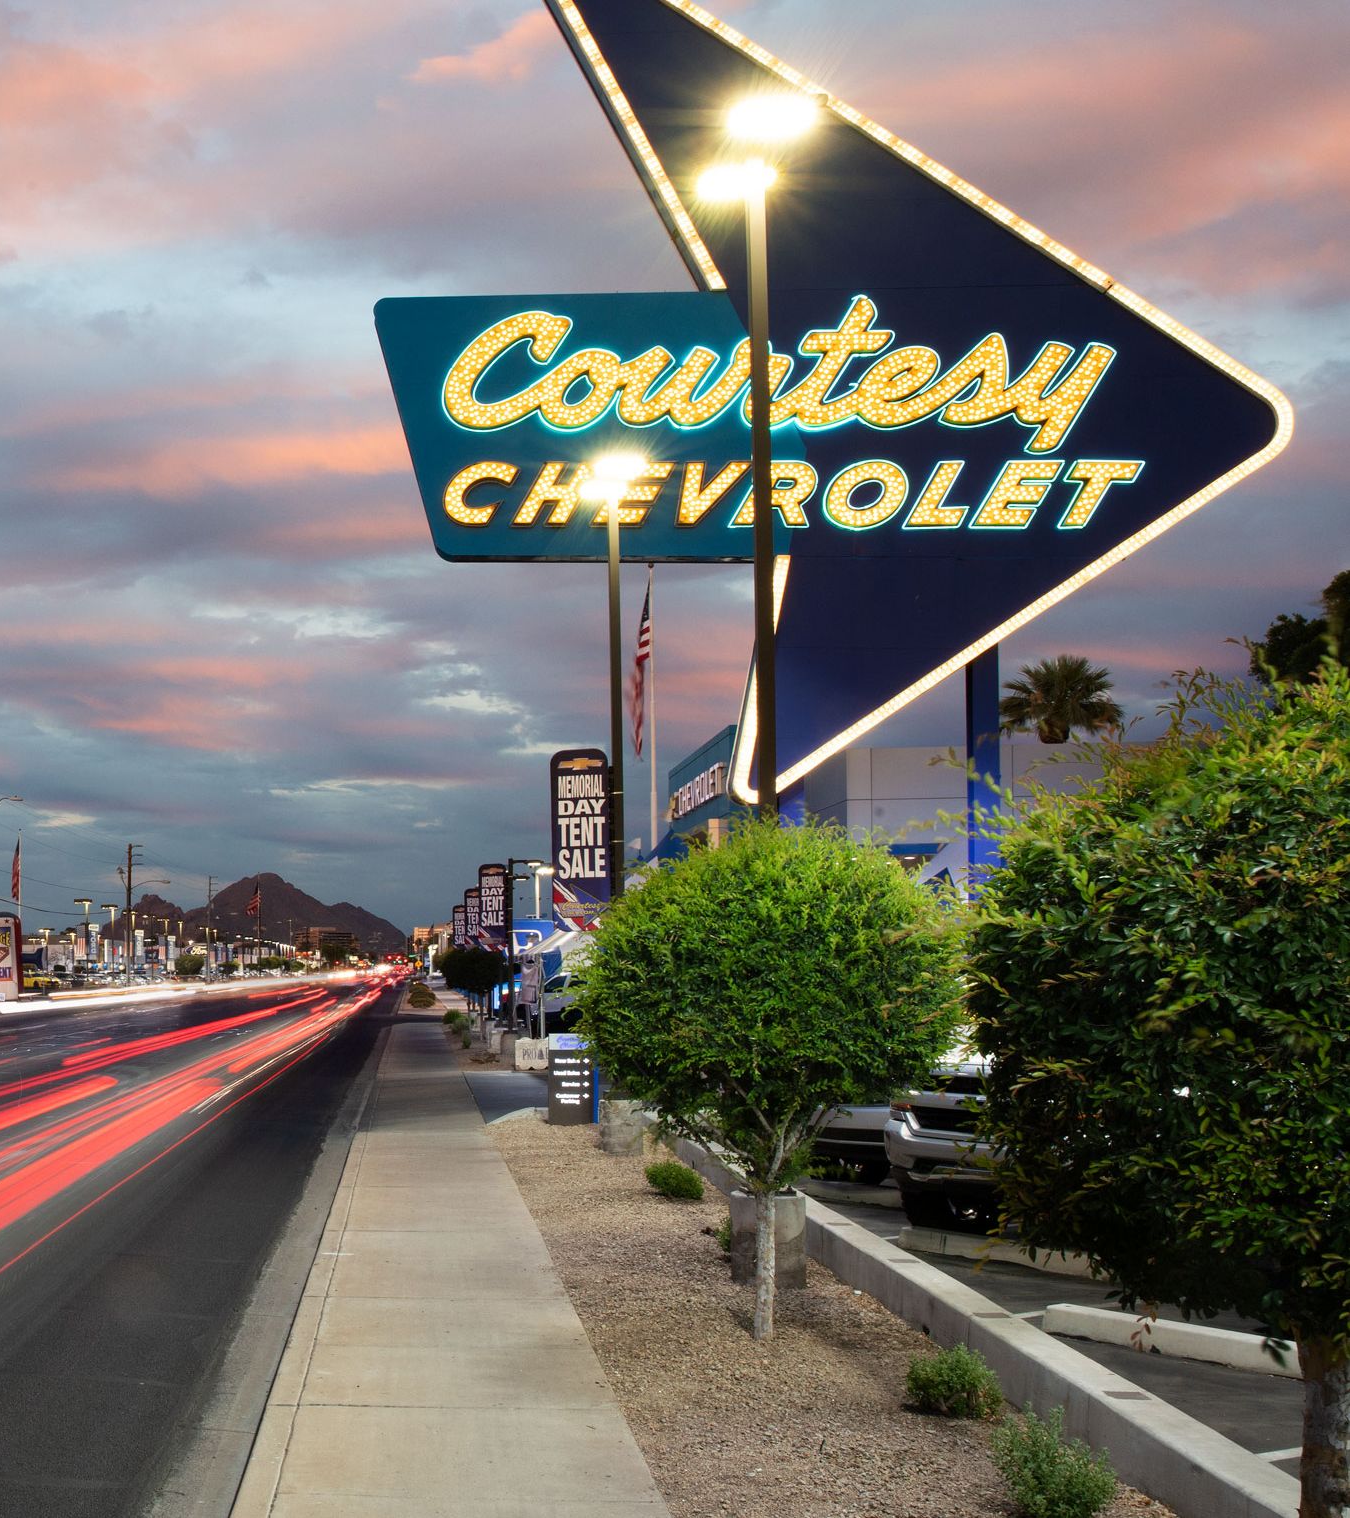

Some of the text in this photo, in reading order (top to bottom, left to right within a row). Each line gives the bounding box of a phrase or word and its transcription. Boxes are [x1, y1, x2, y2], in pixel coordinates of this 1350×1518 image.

[442, 294, 1117, 454] Courtesy
[443, 460, 1145, 531] CHEVROLET
[558, 774, 605, 799] MEMORIAL
[678, 762, 726, 816] CHEVROLET
[558, 799, 606, 816] DAY
[558, 816, 606, 847] TENT
[558, 848, 607, 880] SALE
[481, 888, 505, 896] DAY
[481, 896, 504, 911] TENT
[466, 913, 479, 925] TEN
[481, 911, 504, 927] SALE
[454, 926, 465, 935] TEN
[467, 924, 479, 936] SAL
[454, 935, 465, 945] SAL
